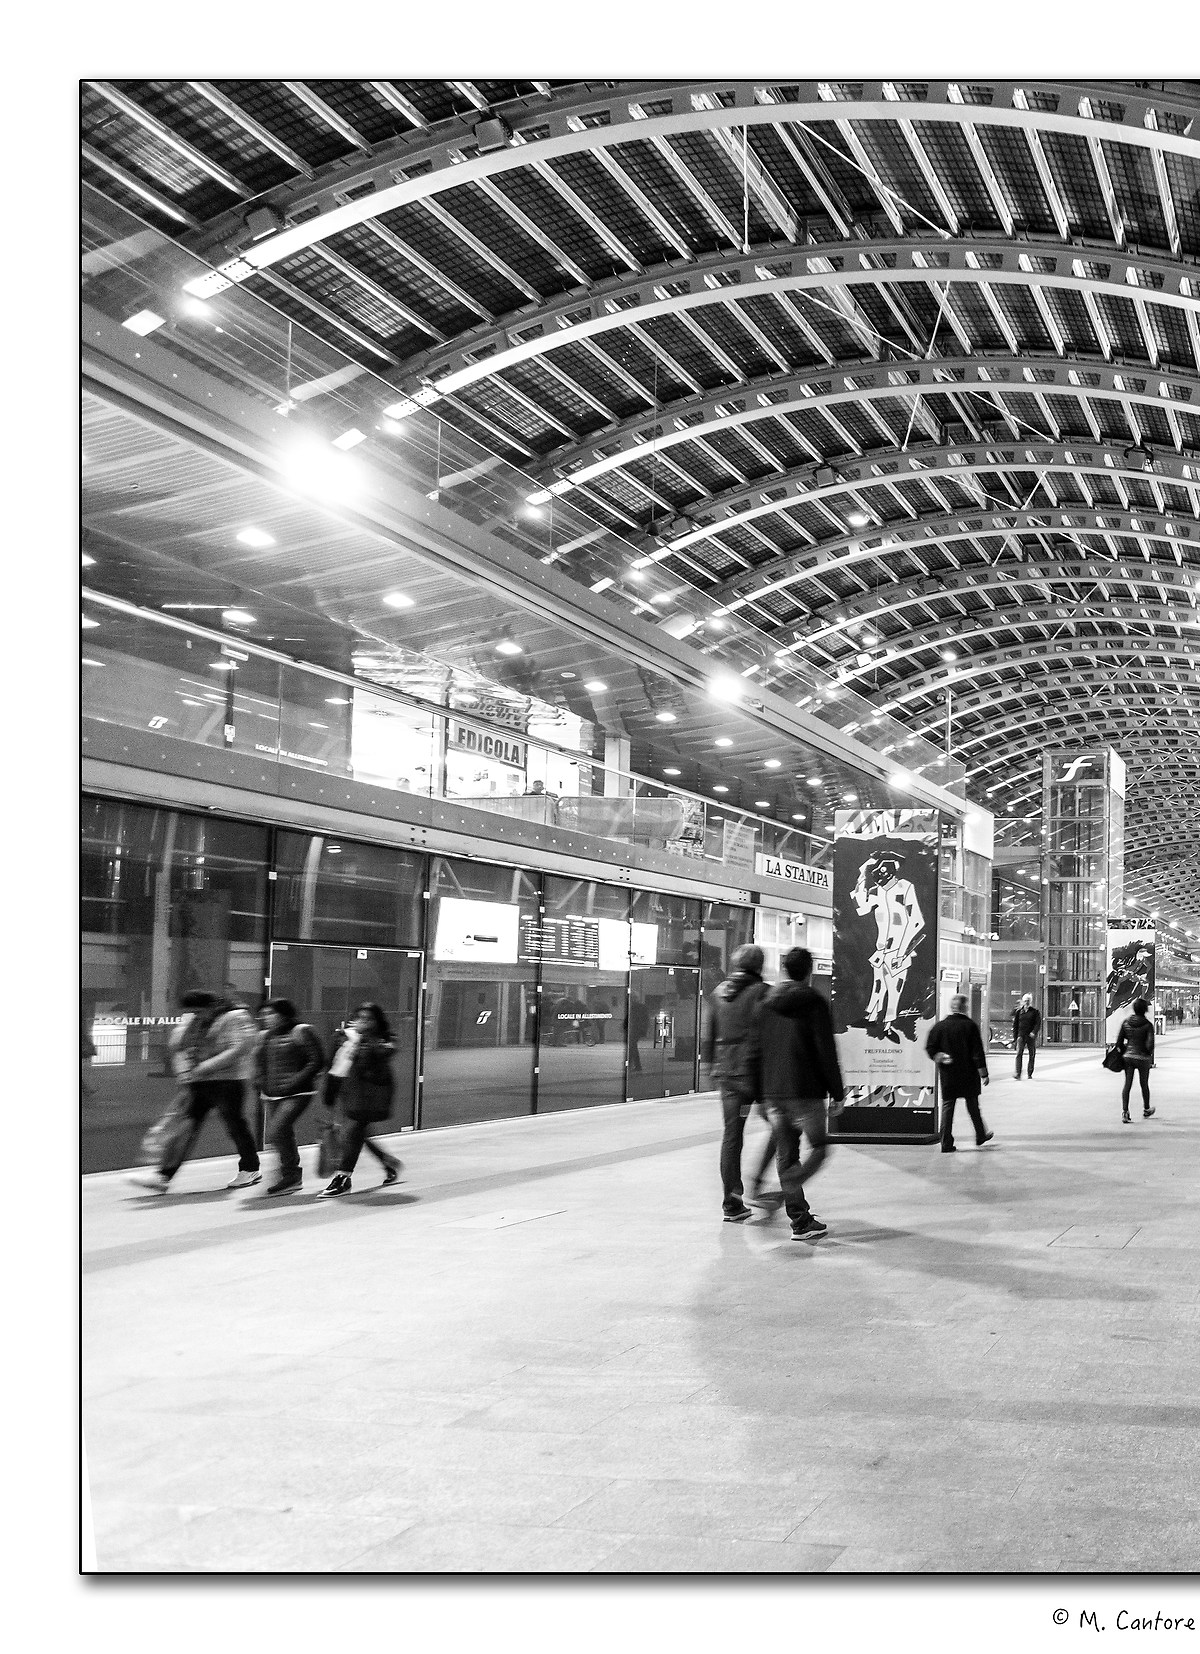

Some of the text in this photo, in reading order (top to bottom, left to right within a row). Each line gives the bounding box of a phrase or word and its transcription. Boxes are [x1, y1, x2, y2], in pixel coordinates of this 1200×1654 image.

[458, 728, 519, 764] EDICOLA
[766, 860, 828, 887] LA STAMPA
[142, 1017, 155, 1025] IN
